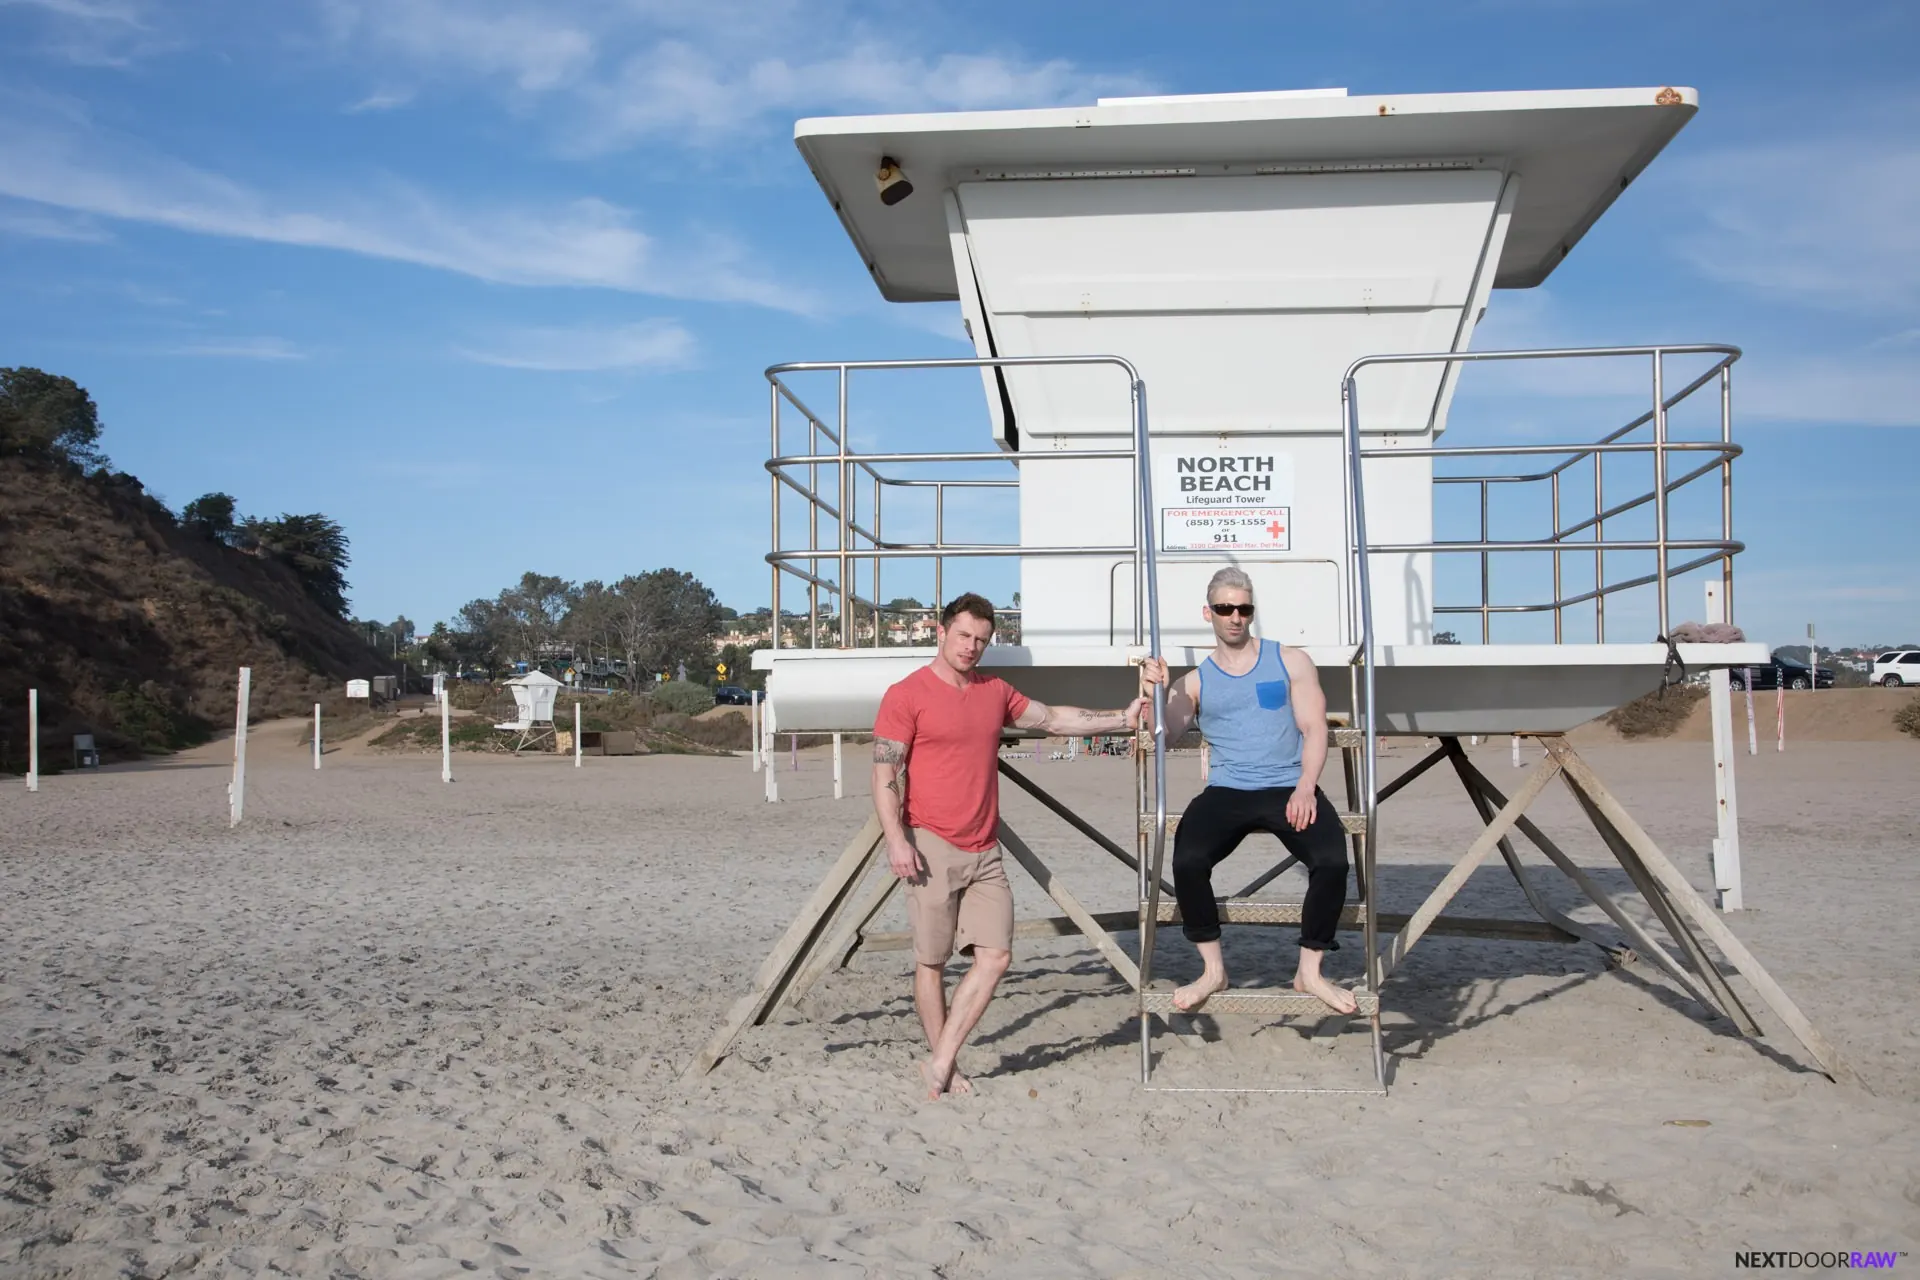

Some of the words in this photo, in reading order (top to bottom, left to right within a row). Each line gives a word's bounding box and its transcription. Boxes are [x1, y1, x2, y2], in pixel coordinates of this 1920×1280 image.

[1177, 456, 1274, 473] NORTH
[1180, 475, 1271, 492] BEACH
[1186, 495, 1232, 505] Lifeguard
[1235, 495, 1266, 504] Tower
[1191, 509, 1256, 517] EMERGENCY
[1185, 518, 1214, 527] (858)
[1217, 518, 1266, 526] 755-1555
[1213, 534, 1238, 543] 911
